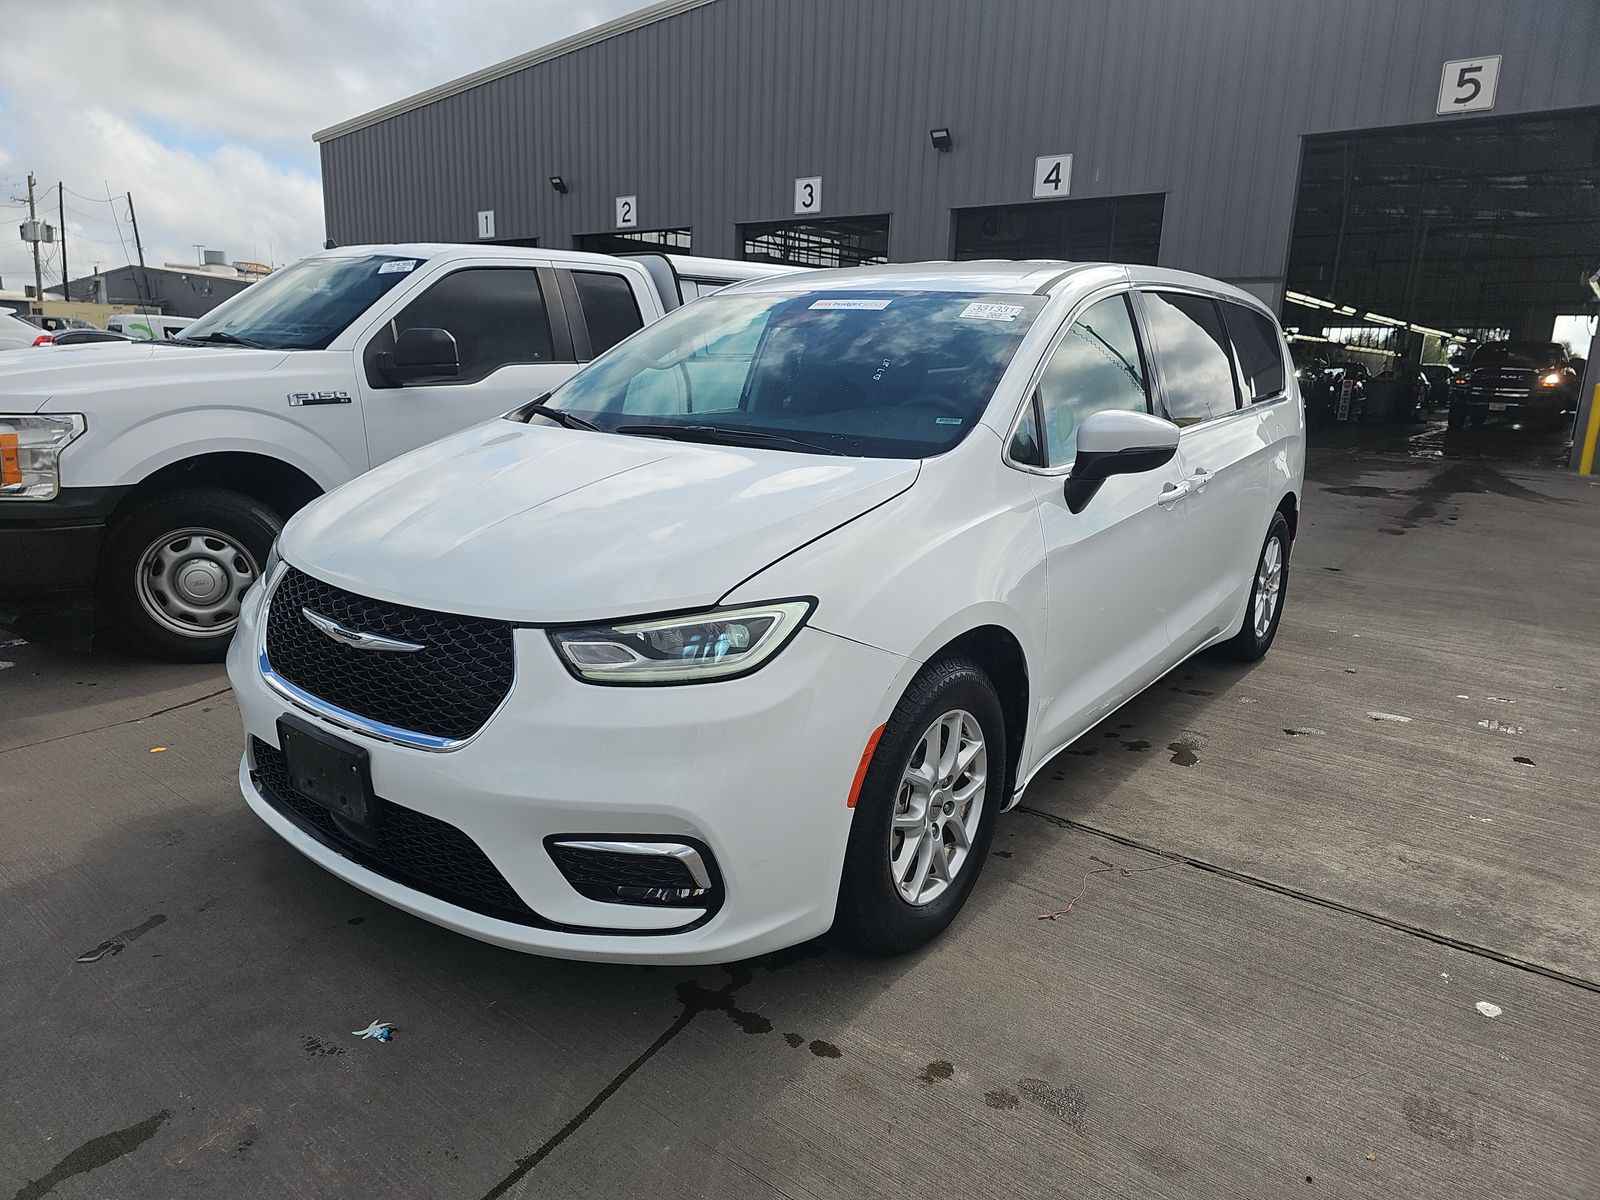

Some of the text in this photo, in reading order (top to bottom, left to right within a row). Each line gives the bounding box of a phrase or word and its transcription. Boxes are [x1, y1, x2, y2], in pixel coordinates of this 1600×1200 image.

[1453, 65, 1483, 104] 5
[1043, 161, 1062, 191] 4
[801, 183, 814, 208] 3
[622, 201, 632, 223] 2
